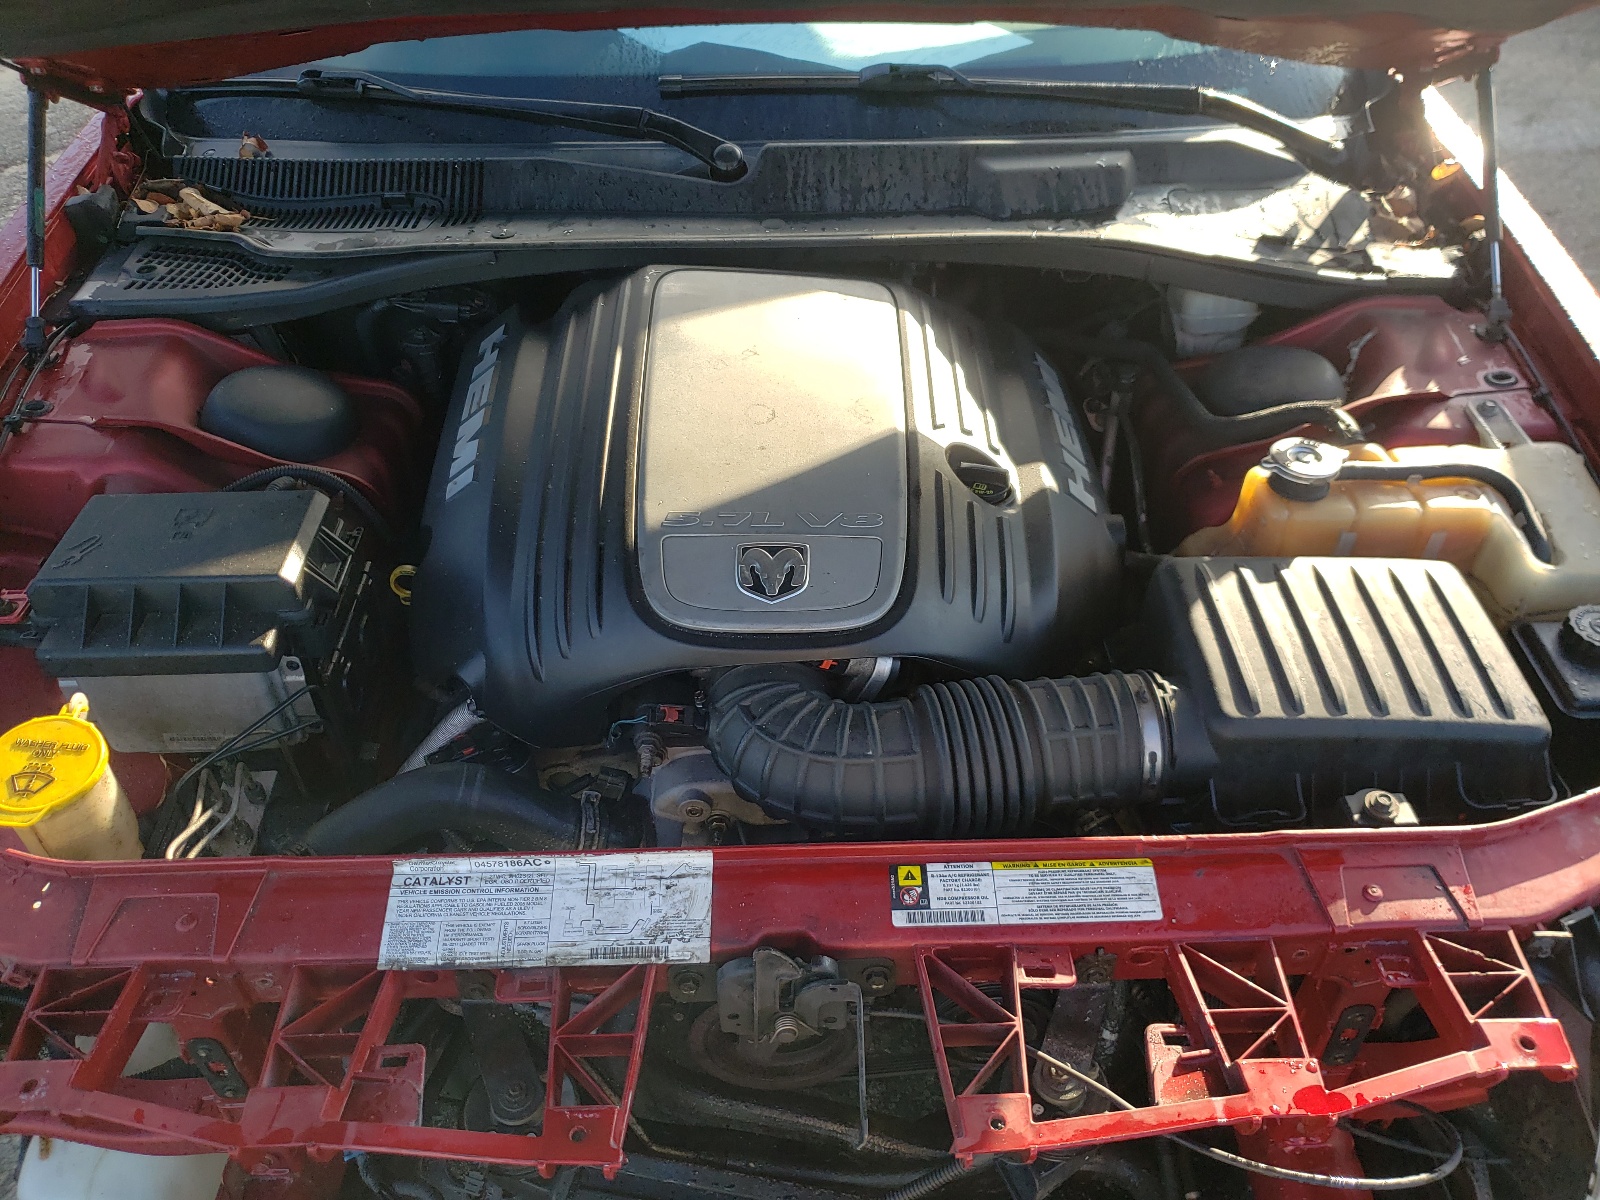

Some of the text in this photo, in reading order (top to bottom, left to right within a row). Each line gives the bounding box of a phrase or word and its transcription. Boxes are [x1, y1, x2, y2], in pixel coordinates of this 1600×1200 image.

[445, 323, 508, 501] HEMI
[660, 511, 885, 528] 5.7L V8
[15, 738, 91, 751] WASHER FLUID
[31, 749, 59, 759] ONLY
[474, 859, 543, 868] 04578186AC
[403, 876, 472, 887] CATALYST
